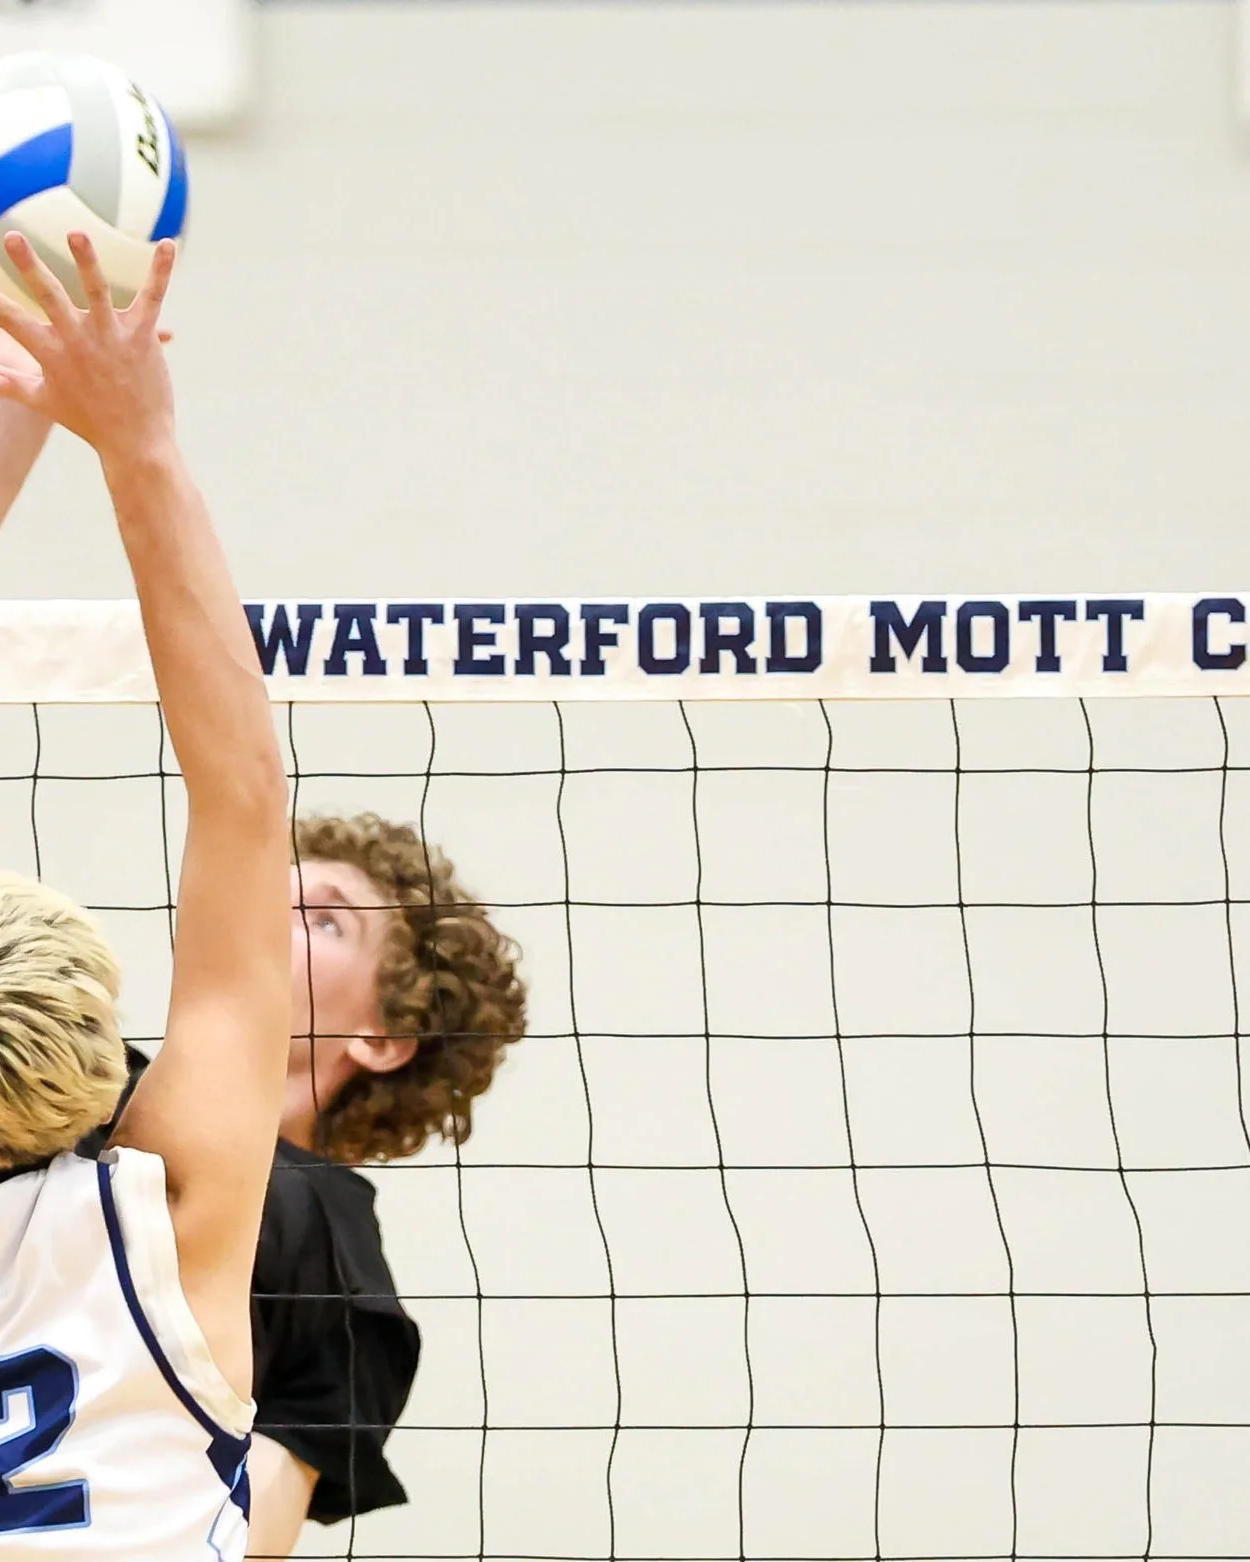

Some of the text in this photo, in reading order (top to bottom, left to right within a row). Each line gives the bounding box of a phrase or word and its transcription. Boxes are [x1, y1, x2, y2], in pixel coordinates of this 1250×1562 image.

[242, 597, 1248, 676] WATERFORD MOTT C
